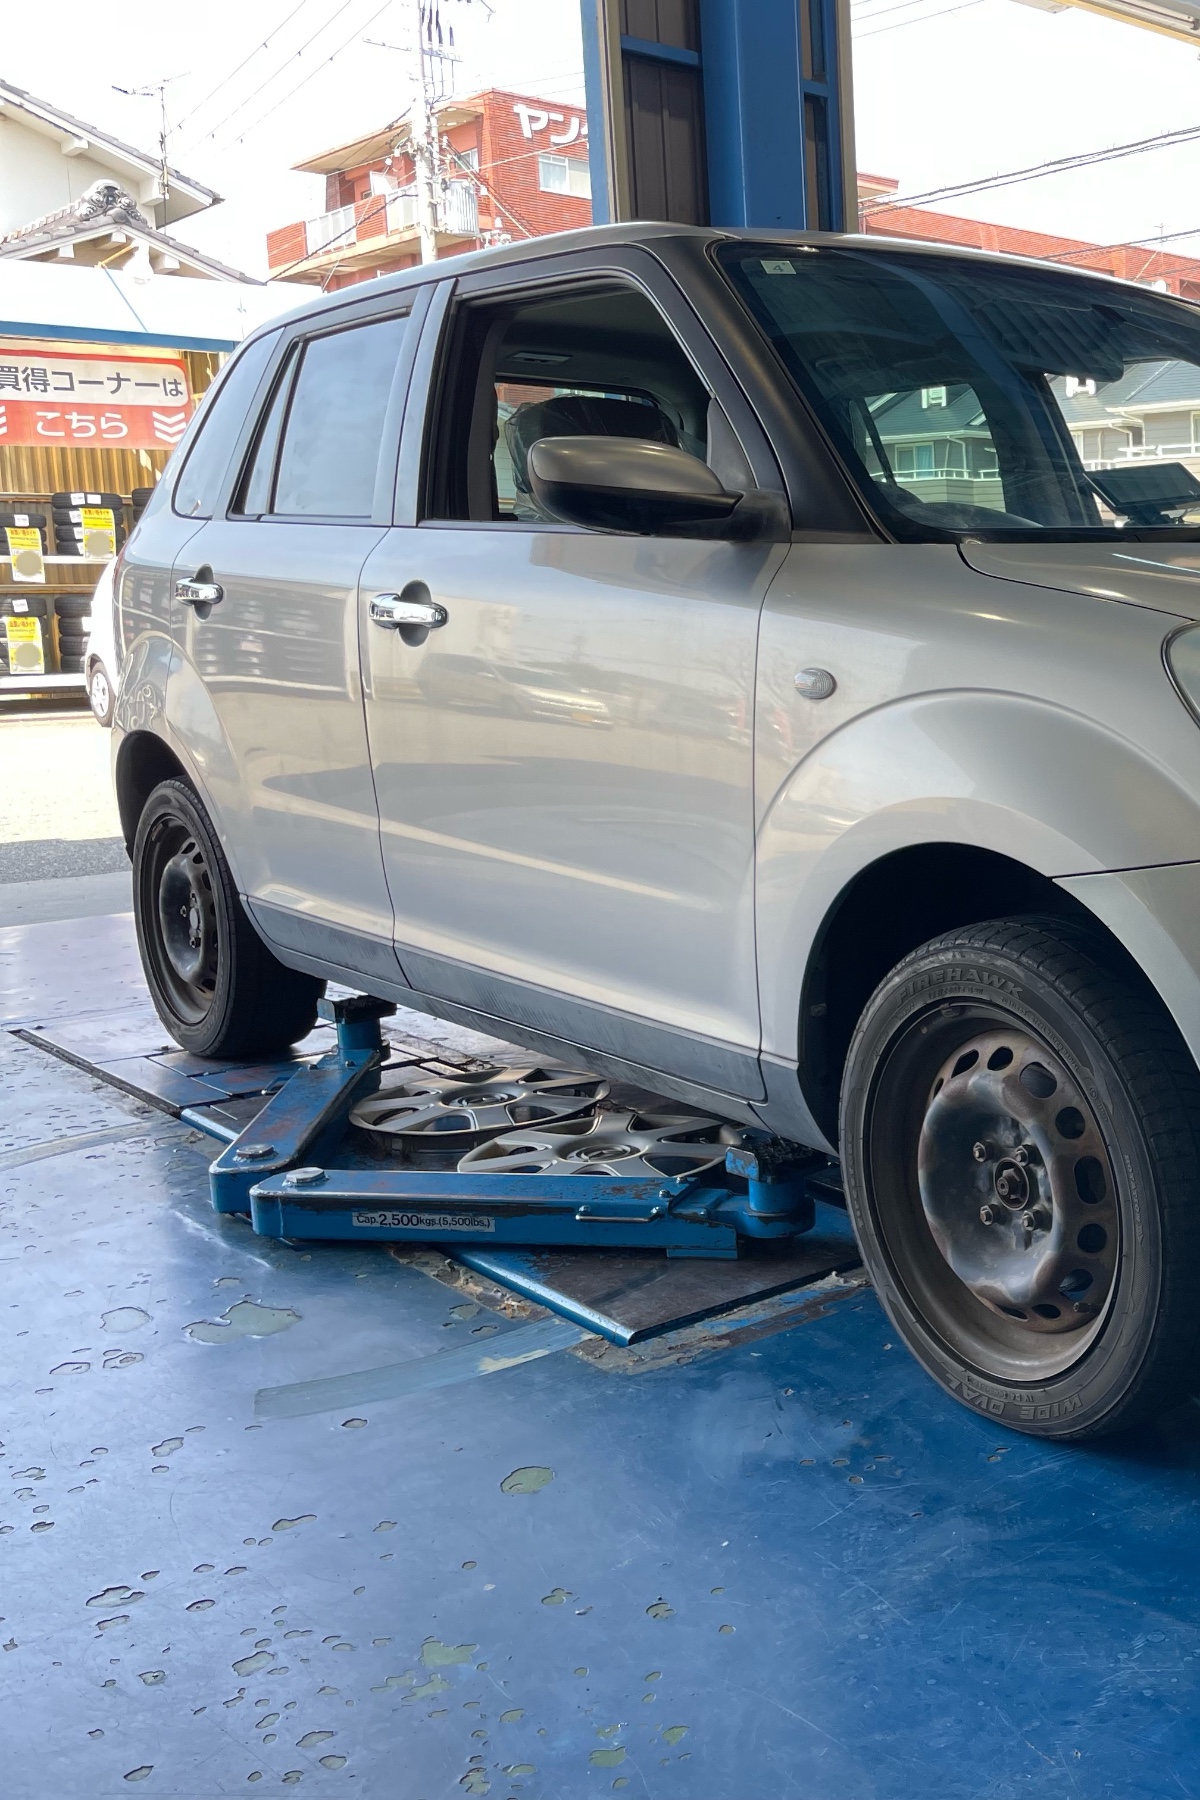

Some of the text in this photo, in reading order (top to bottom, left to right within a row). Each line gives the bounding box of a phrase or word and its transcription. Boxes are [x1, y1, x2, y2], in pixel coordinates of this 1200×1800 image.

[513, 103, 588, 149] ヤン
[0, 364, 183, 397] 買得コーナーは
[36, 411, 128, 438] こちら
[895, 968, 1023, 1004] FIREHAWK
[944, 1373, 1005, 1415] OVAL
[1019, 1394, 1083, 1420] WIDE
